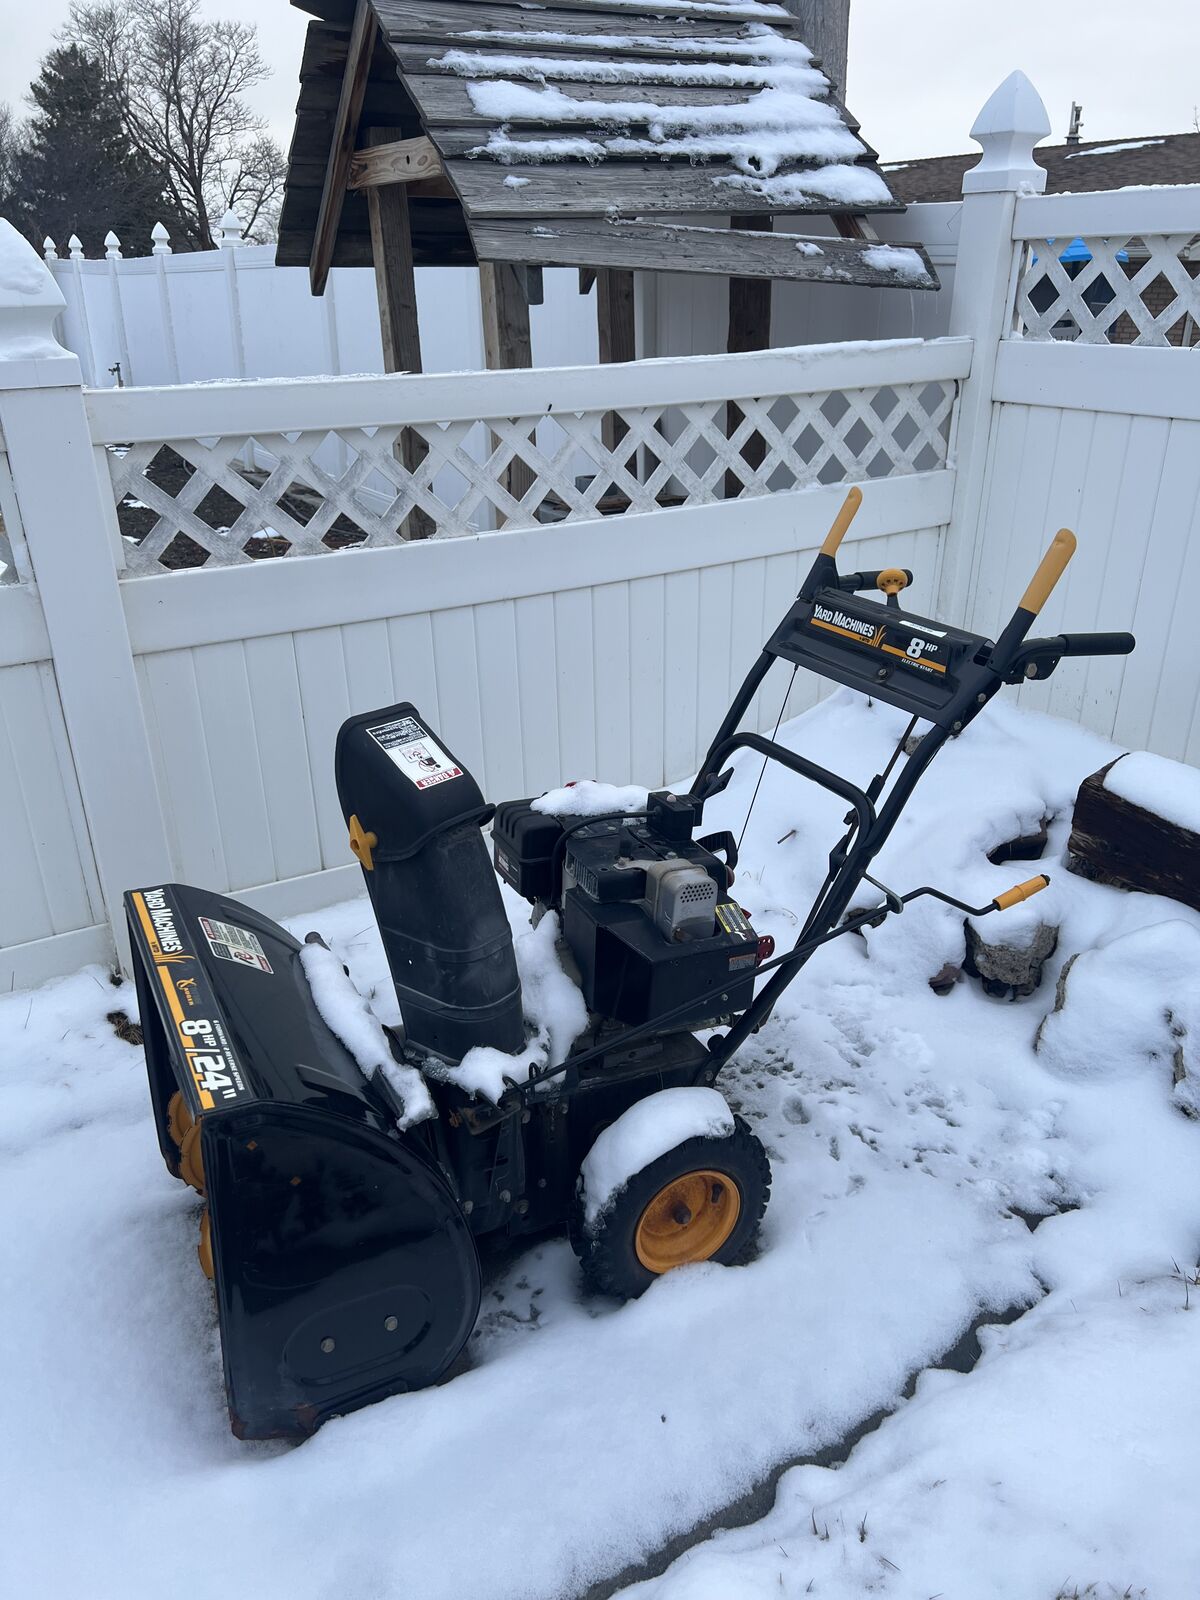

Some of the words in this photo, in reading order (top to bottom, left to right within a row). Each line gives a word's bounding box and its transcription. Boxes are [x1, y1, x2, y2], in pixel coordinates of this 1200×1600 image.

[813, 604, 833, 622] YARD
[832, 611, 875, 637] MACHINES
[906, 637, 926, 659] 8
[925, 643, 938, 653] HP
[143, 888, 166, 909] YARD
[150, 908, 183, 952] MACHINES
[181, 1019, 212, 1035] 8
[202, 1034, 217, 1047] HP
[225, 1050, 238, 1072] REVERSE
[232, 1071, 245, 1091] SPEEDS
